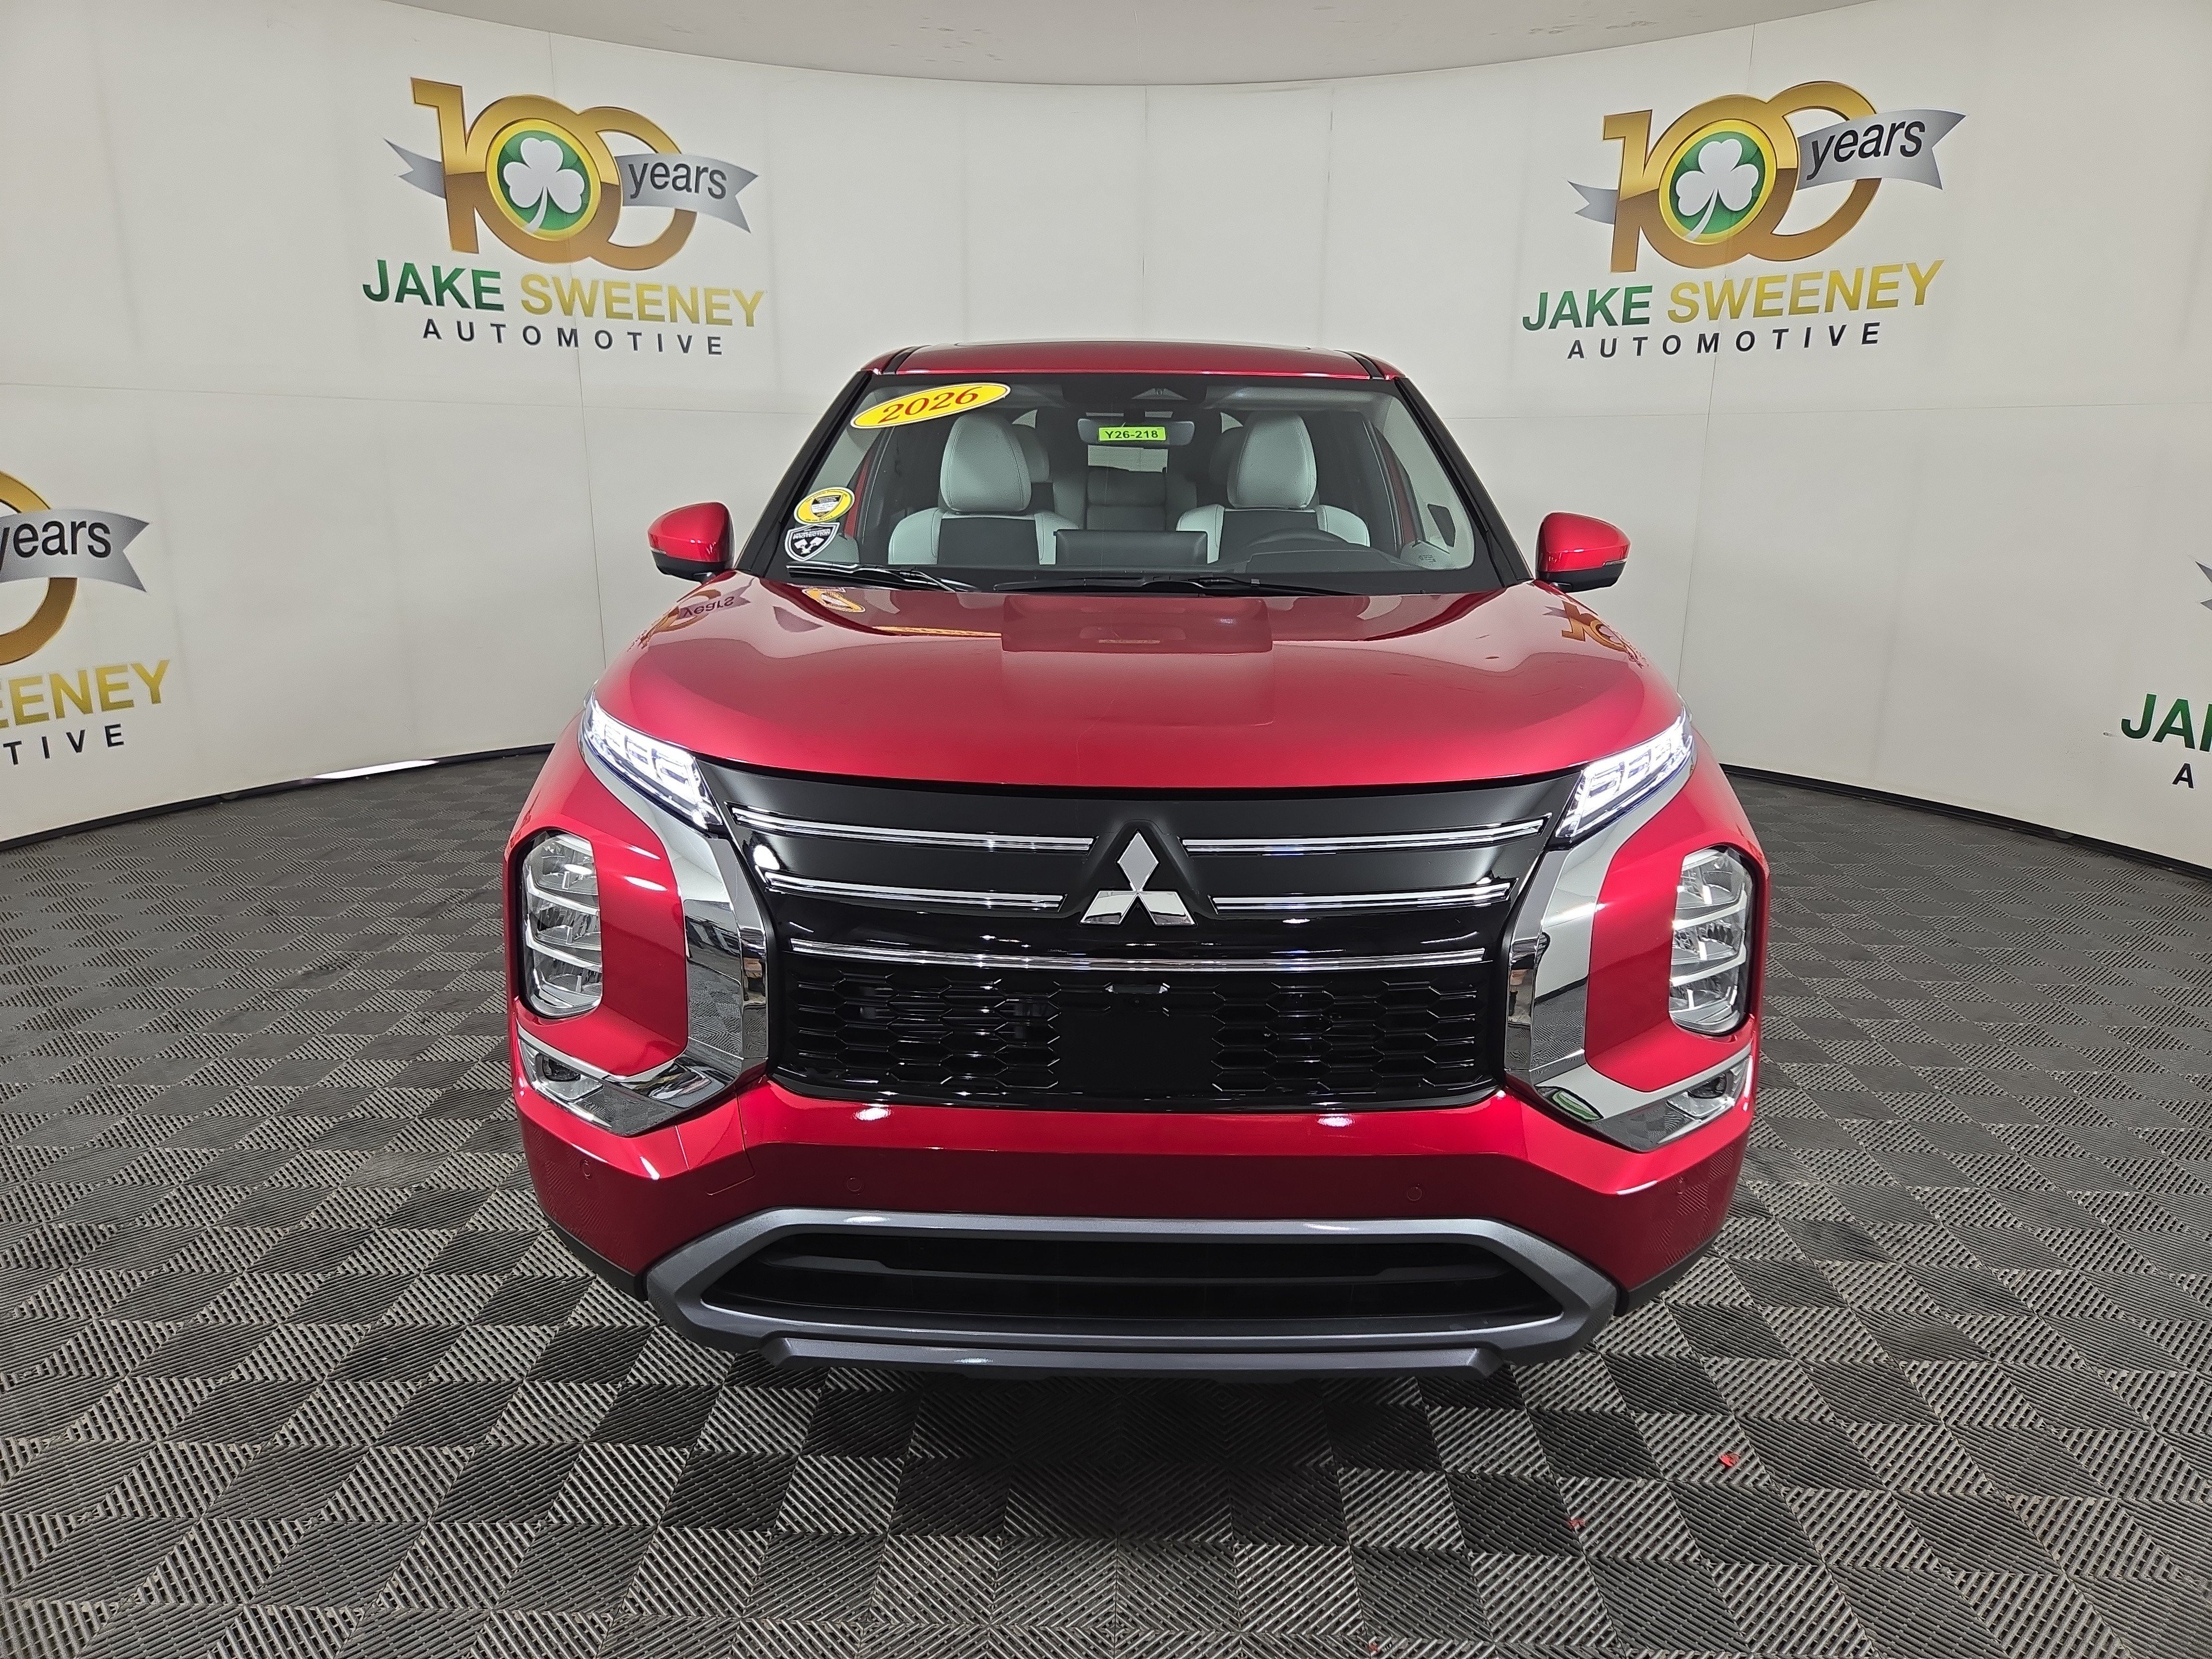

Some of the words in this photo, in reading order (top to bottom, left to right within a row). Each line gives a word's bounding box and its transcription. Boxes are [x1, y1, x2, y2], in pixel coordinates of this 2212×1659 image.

[1807, 118, 1926, 181] years
[628, 160, 728, 199] years
[362, 259, 504, 311] JAKE
[520, 274, 764, 326] SWEENEY
[1522, 285, 1652, 331] JAKE
[1667, 259, 1945, 323] SWEENEY
[423, 319, 723, 355] AUTOMOTIVE
[1567, 322, 1881, 359] AUTOMOTIVE
[878, 387, 982, 424] 2026
[1104, 430, 1159, 439] Y26-218
[2121, 693, 2212, 752] JA
